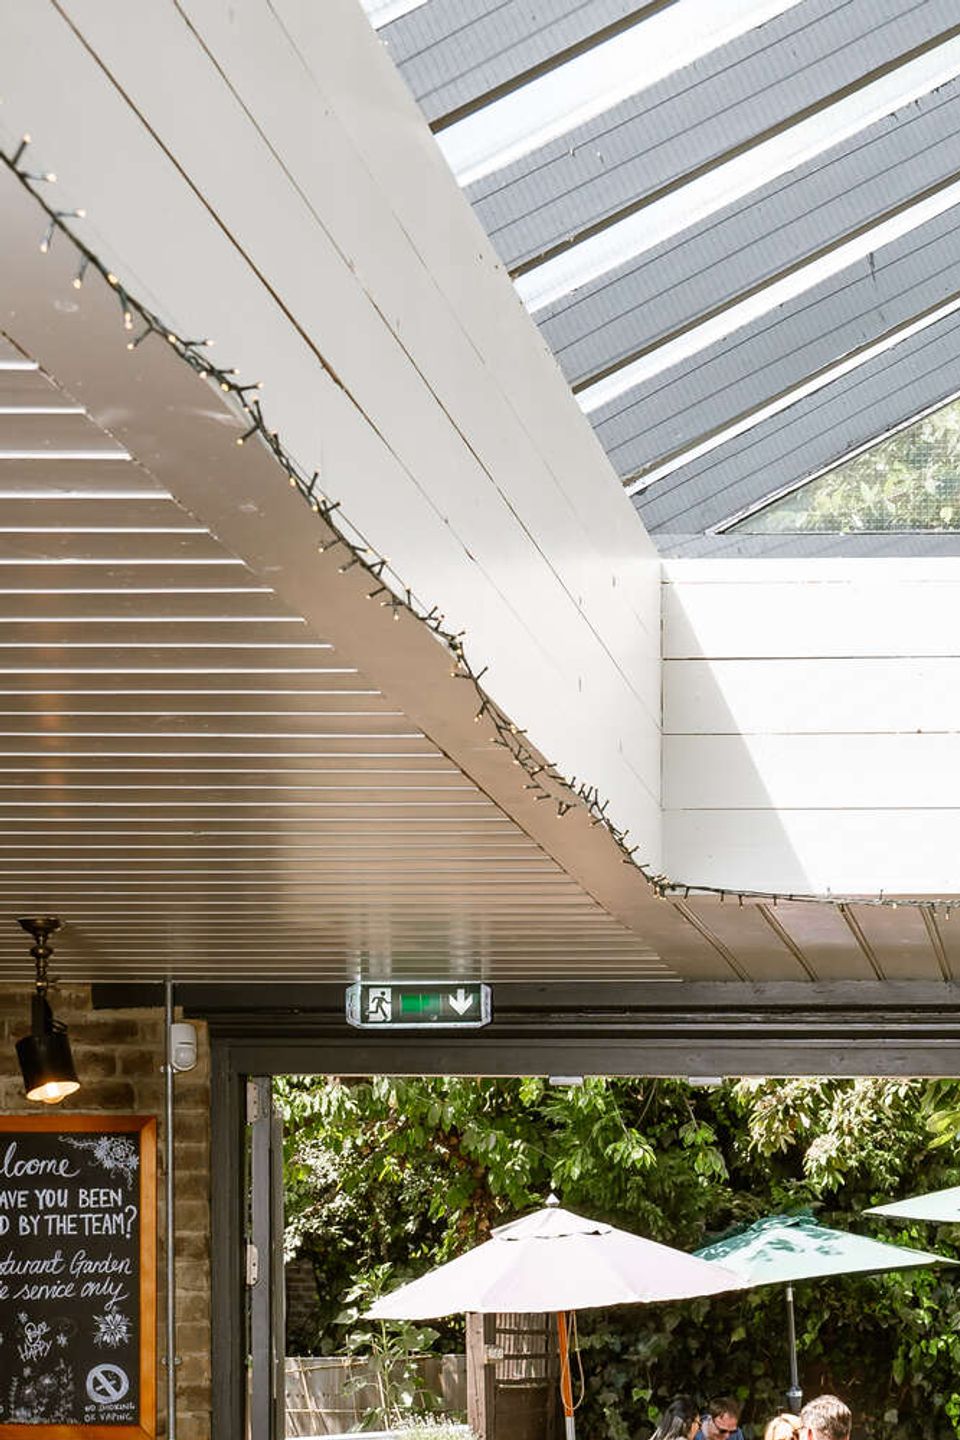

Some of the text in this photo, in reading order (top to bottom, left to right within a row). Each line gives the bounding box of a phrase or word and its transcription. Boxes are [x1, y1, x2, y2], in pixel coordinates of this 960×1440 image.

[0, 1142, 80, 1177] lcome
[34, 1189, 68, 1209] YOU
[79, 1188, 122, 1208] BEEN
[19, 1214, 40, 1235] BY
[44, 1214, 78, 1236] THE
[79, 1205, 137, 1239] TEAM?
[70, 1250, 132, 1278] Garden
[13, 1281, 76, 1300] service
[81, 1277, 130, 1311] only
